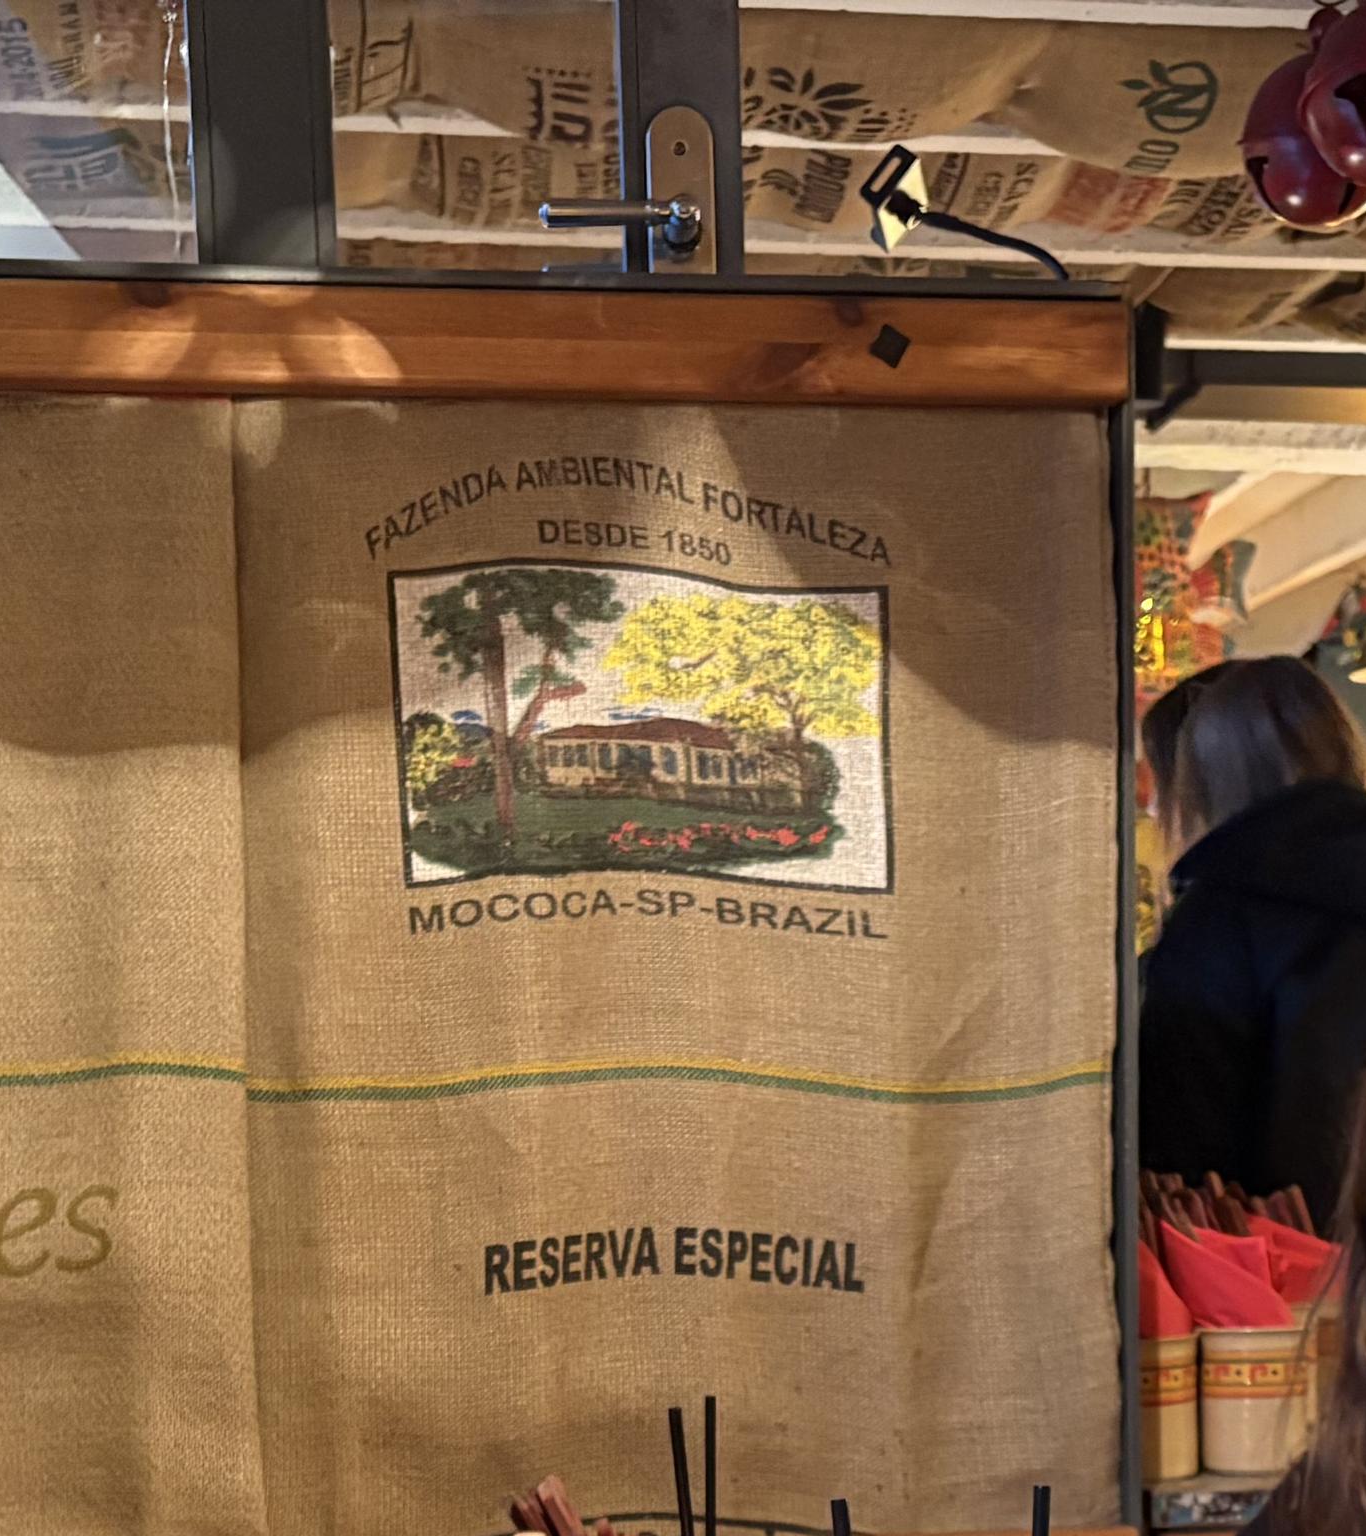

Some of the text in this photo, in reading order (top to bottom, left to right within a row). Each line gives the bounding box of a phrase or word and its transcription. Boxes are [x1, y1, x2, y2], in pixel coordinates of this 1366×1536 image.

[364, 456, 891, 567] FAZENDA AMBIENTAL FORTALEZA
[538, 518, 733, 567] DESDE 1850
[409, 888, 889, 940] MOCOCA-SP-BRAZIL
[484, 1226, 866, 1296] RESERVA ESPECIAL
